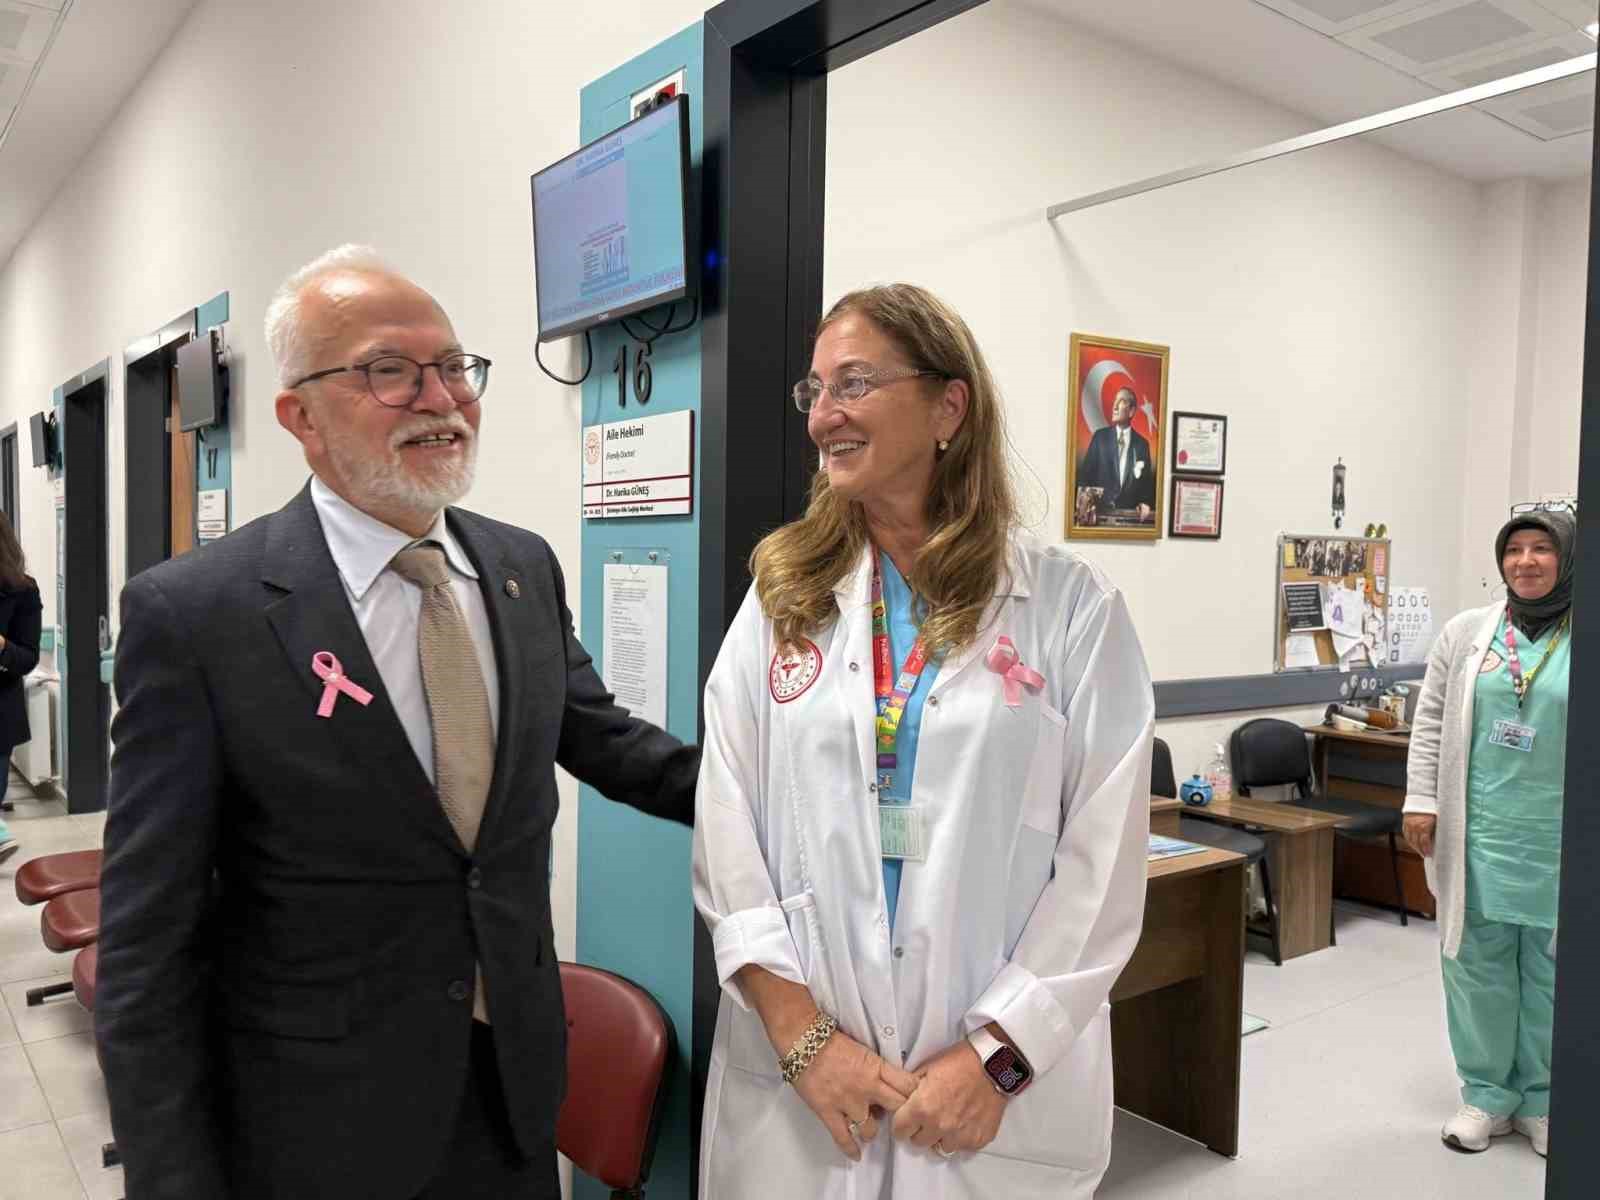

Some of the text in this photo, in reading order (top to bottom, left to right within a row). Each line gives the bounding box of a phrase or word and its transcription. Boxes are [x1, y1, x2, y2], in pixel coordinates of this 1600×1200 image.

[613, 345, 652, 408] 16
[607, 424, 644, 440] Aile Hekimi
[631, 485, 650, 497] GÜNEŞ
